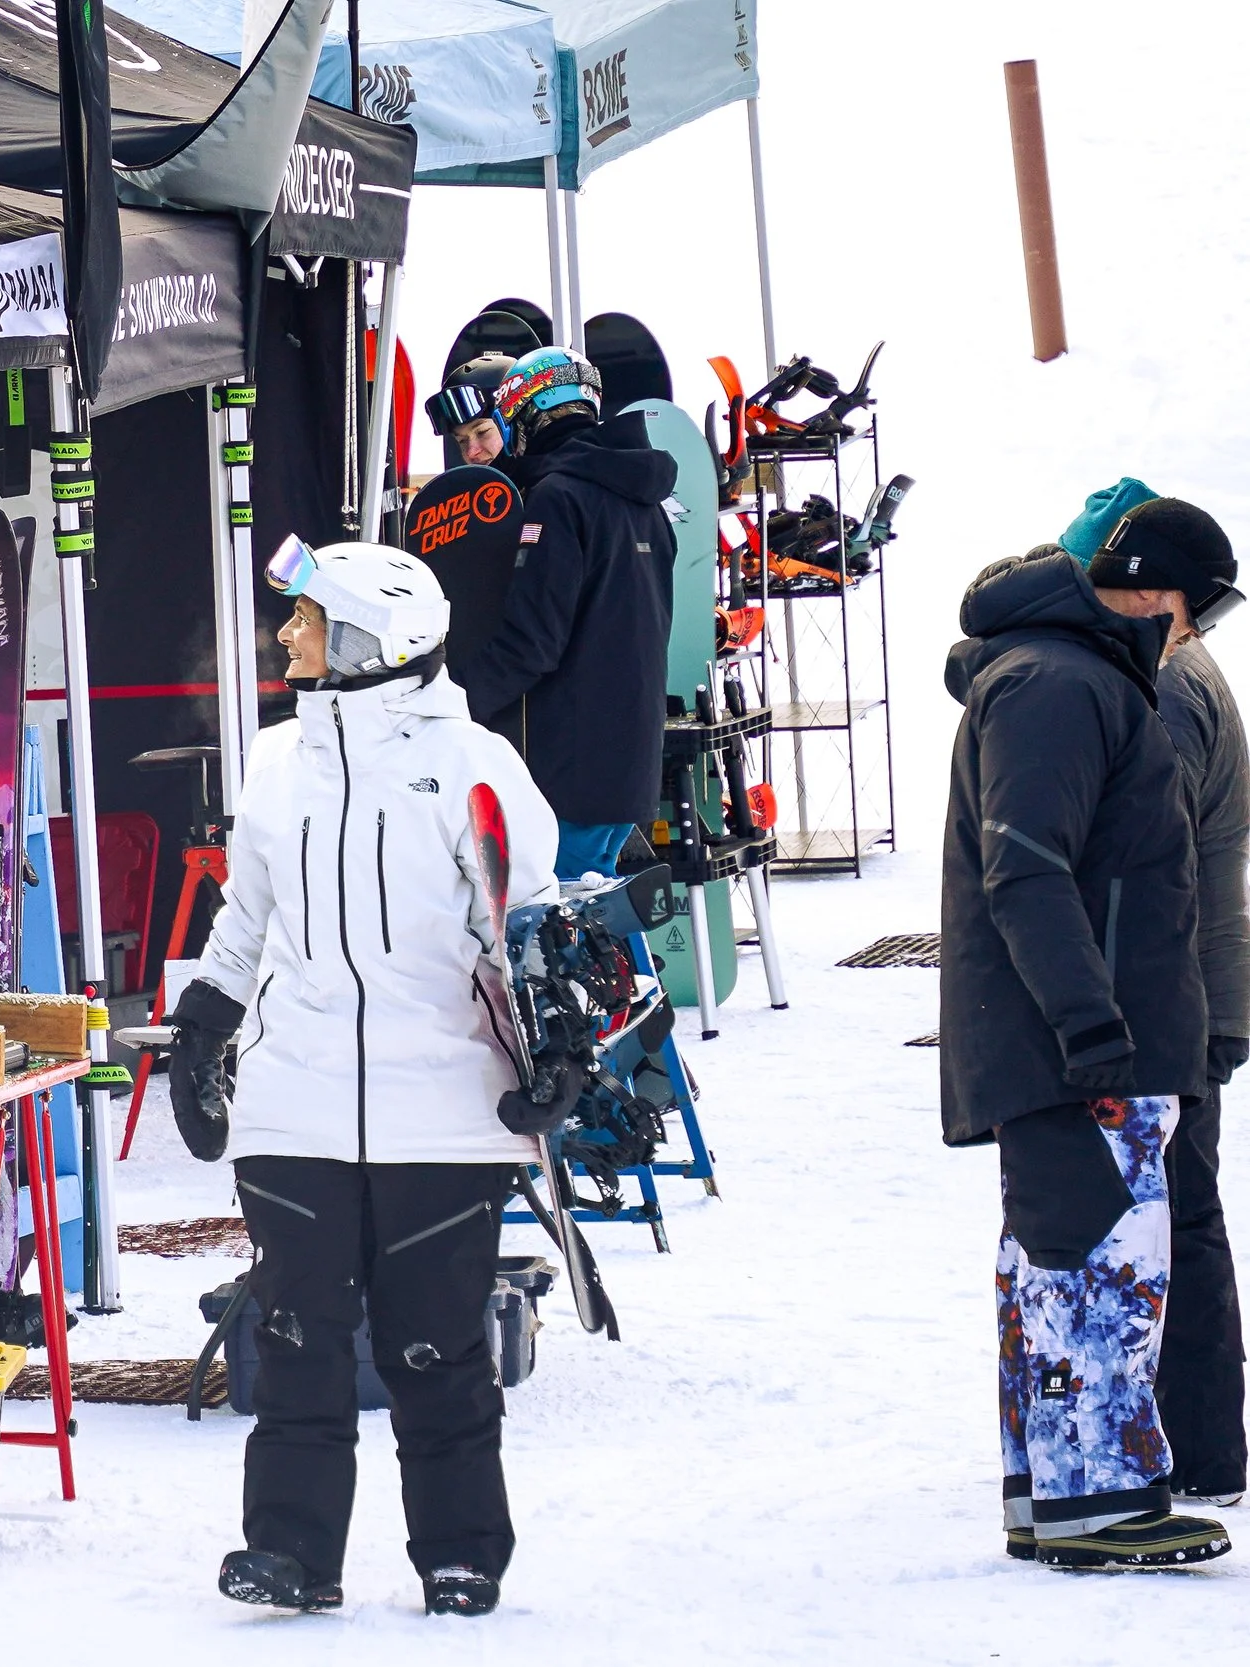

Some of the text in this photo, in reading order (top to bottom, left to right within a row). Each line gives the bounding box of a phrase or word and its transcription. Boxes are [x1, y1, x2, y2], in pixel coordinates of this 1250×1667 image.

[359, 63, 418, 123] ROME
[583, 48, 629, 132] ROME
[129, 275, 198, 338] SNOWBOARD
[198, 273, 219, 324] CO.
[51, 447, 80, 455] MADA
[409, 491, 471, 536] SANTA
[421, 514, 471, 554] CRUZ
